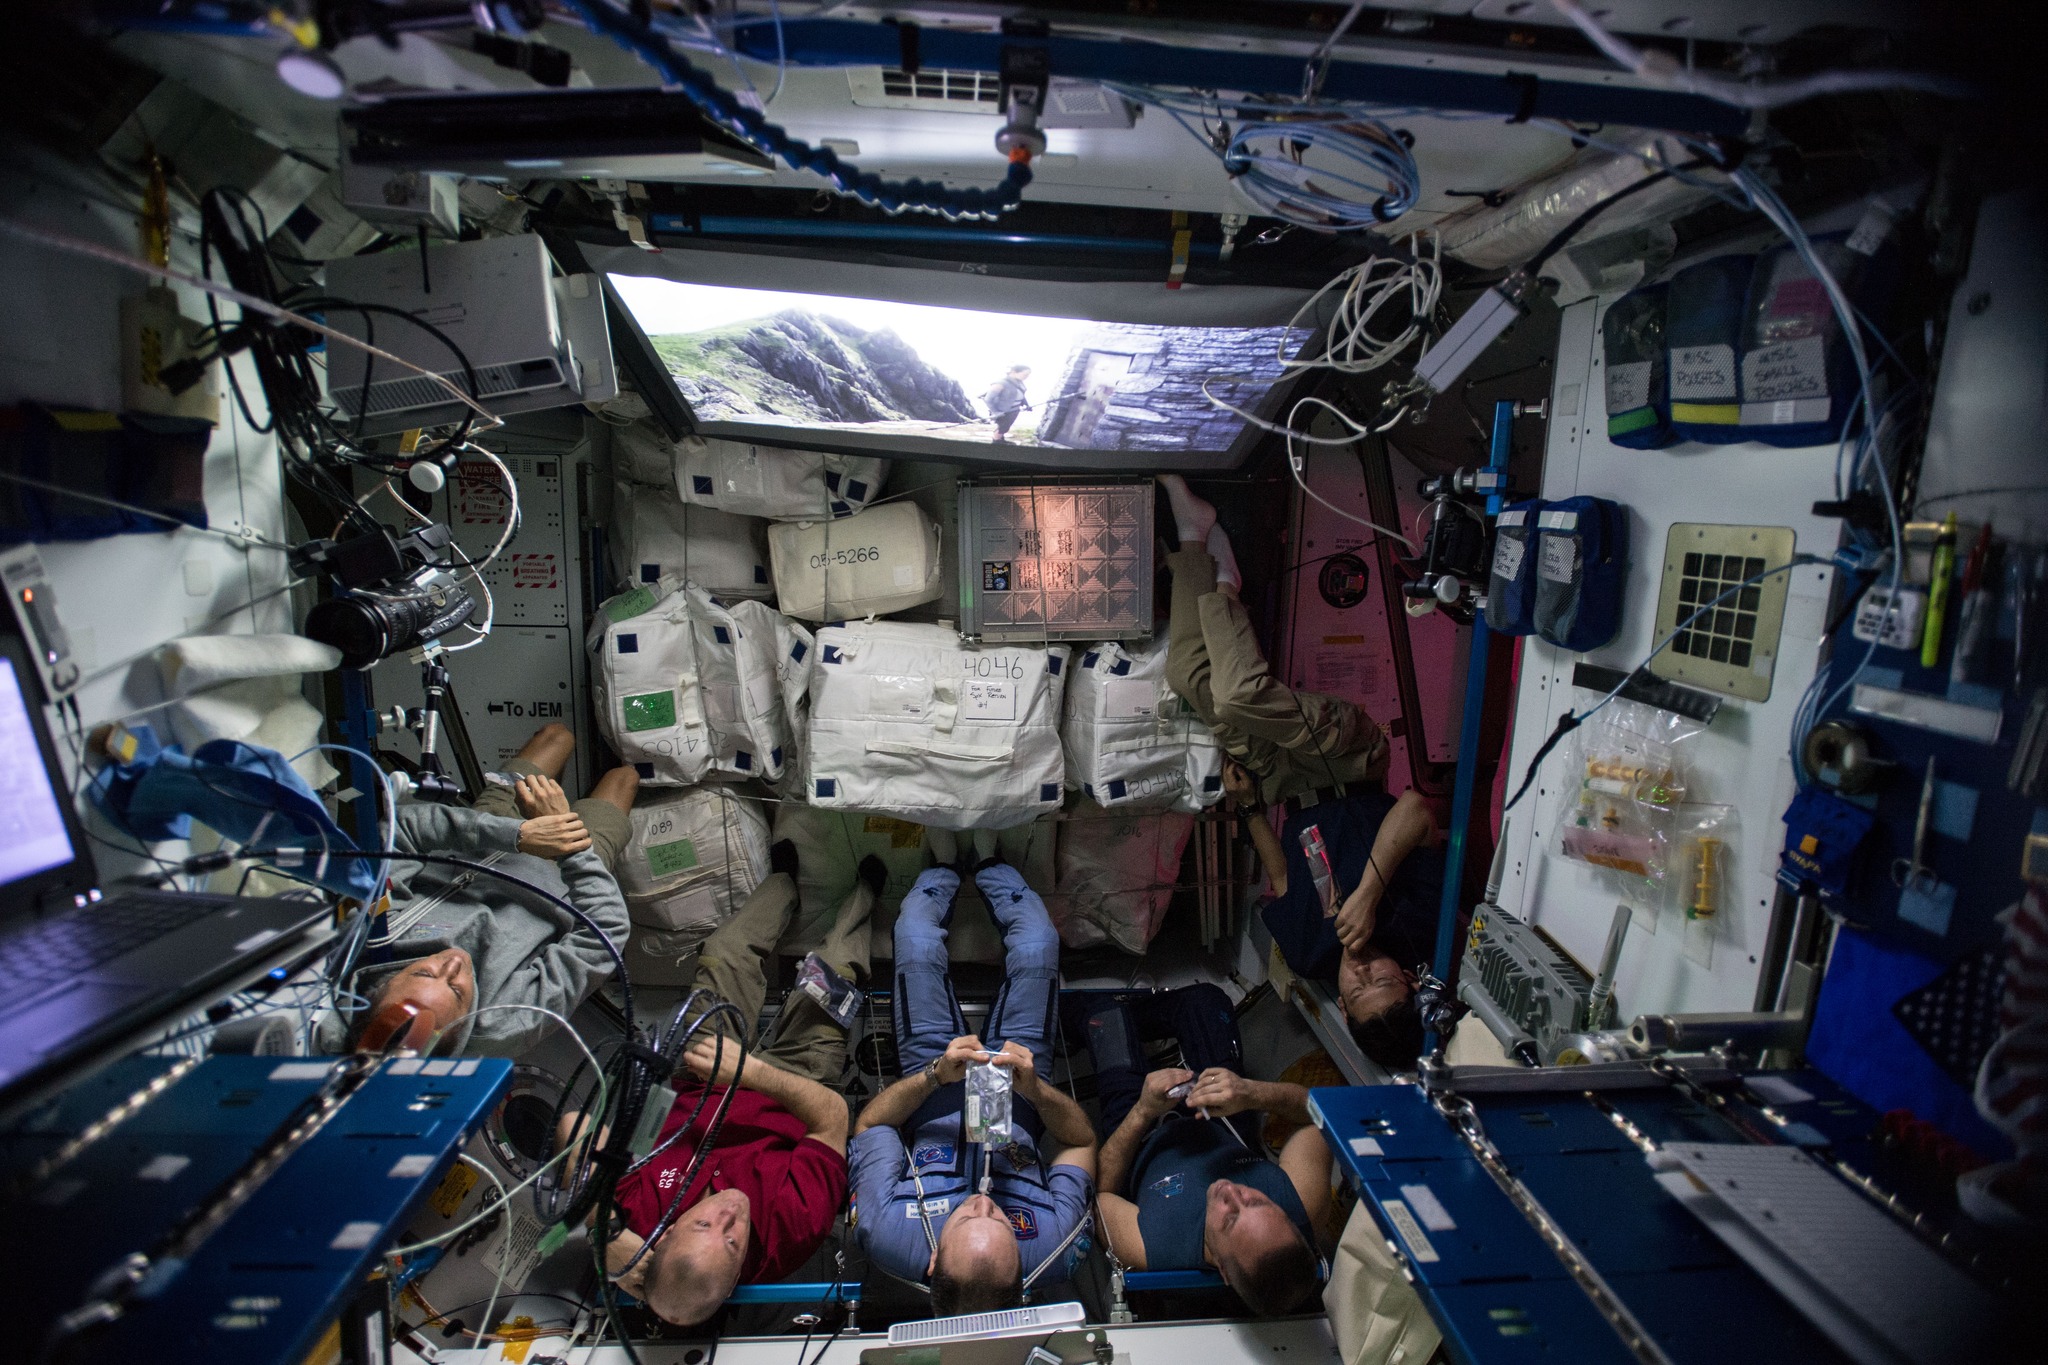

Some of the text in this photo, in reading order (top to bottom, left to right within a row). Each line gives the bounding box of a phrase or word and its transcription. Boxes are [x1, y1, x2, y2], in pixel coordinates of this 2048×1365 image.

[463, 465, 497, 474] WATER
[964, 656, 1024, 679] 4046
[503, 701, 562, 718] To JEM
[647, 820, 673, 837] 1089
[660, 1167, 678, 1178] 54
[658, 1178, 675, 1189] 53
